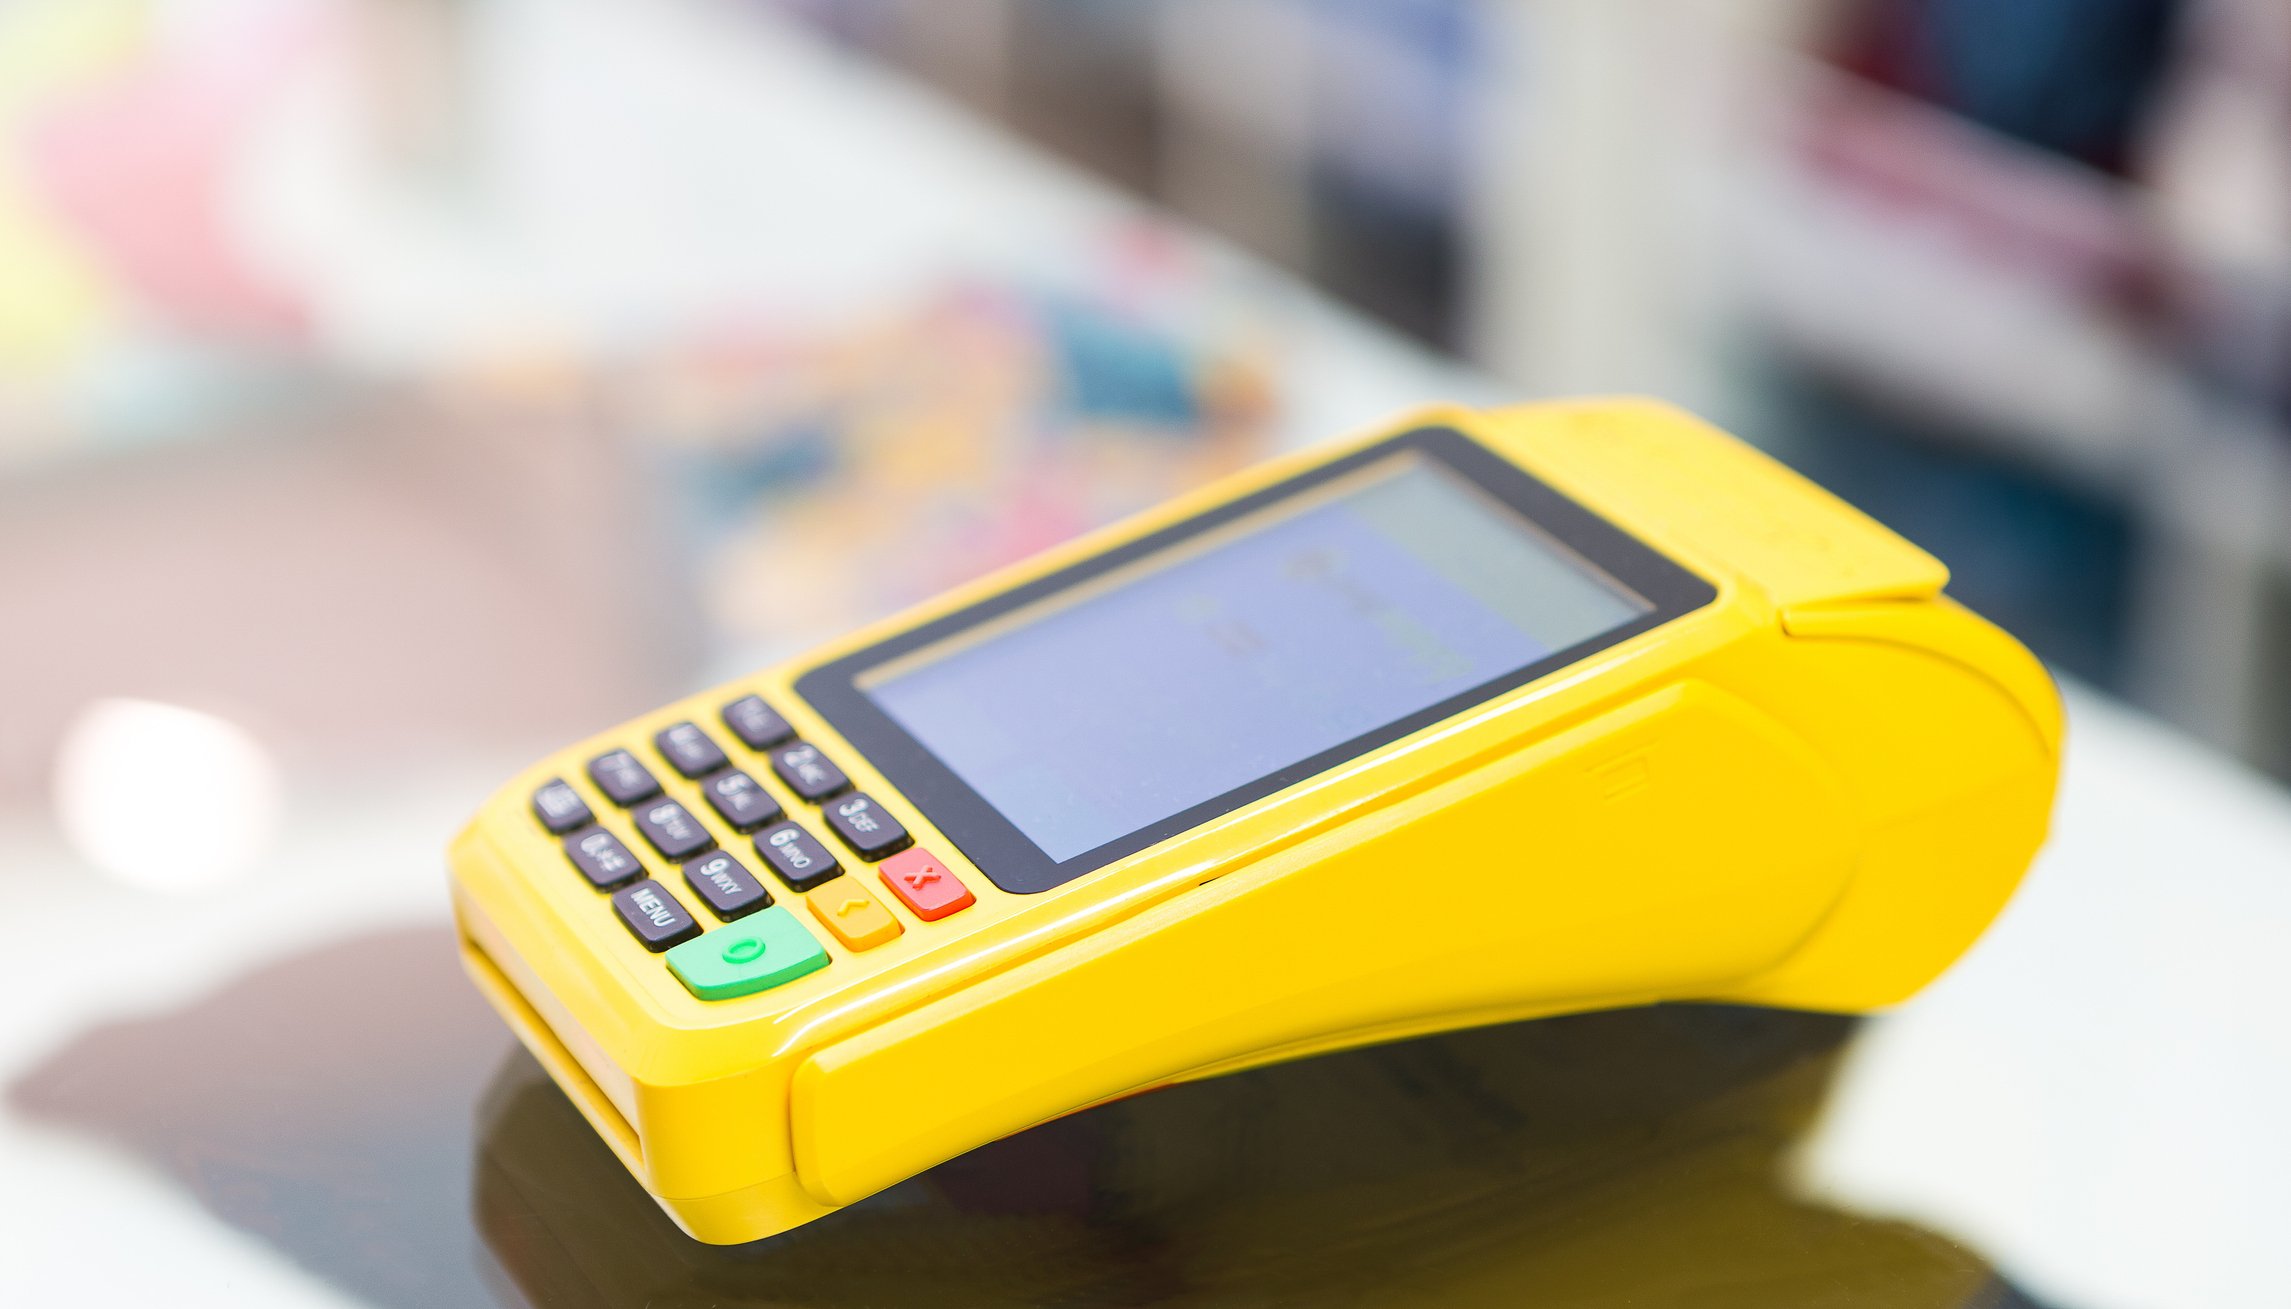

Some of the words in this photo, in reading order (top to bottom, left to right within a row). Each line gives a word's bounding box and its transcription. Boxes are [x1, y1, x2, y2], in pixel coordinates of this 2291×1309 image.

[783, 745, 818, 768] 2
[838, 798, 868, 817] 3
[769, 828, 800, 847] 6
[700, 858, 729, 876] 9
[630, 887, 676, 927] MENU
